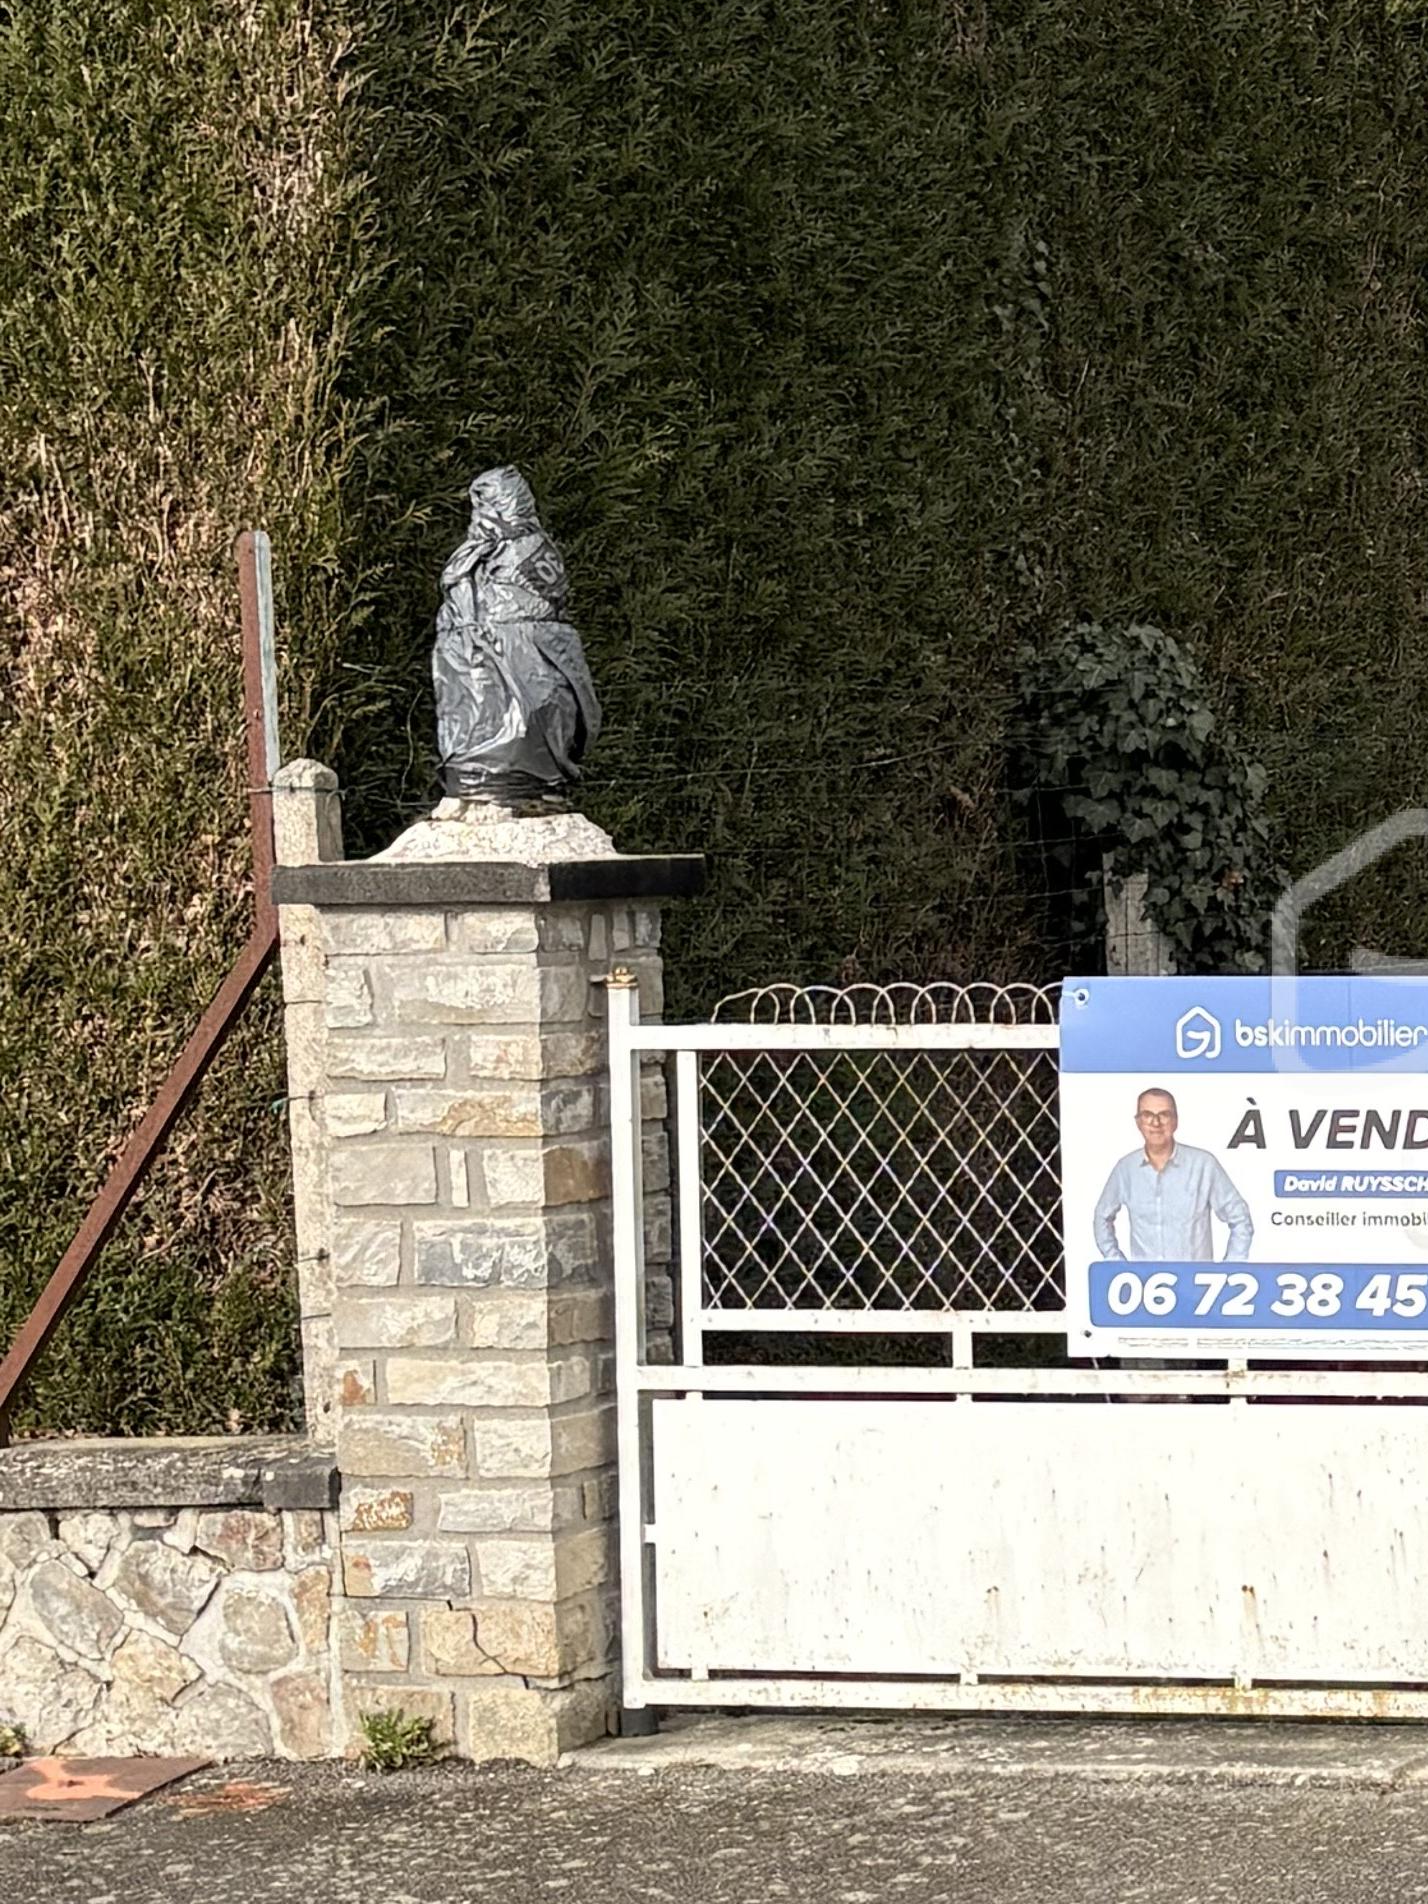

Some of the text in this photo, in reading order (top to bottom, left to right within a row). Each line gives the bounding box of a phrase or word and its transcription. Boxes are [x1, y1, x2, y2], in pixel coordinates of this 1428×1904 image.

[1235, 1018, 1428, 1047] bskimmobilier
[1227, 1097, 1267, 1150] À
[1284, 1176, 1337, 1192] David
[1271, 1212, 1357, 1226] Conseiller
[1107, 1272, 1178, 1316] 06
[1194, 1273, 1260, 1317] 72
[1270, 1273, 1345, 1318] 38
[1356, 1274, 1428, 1318] 45
